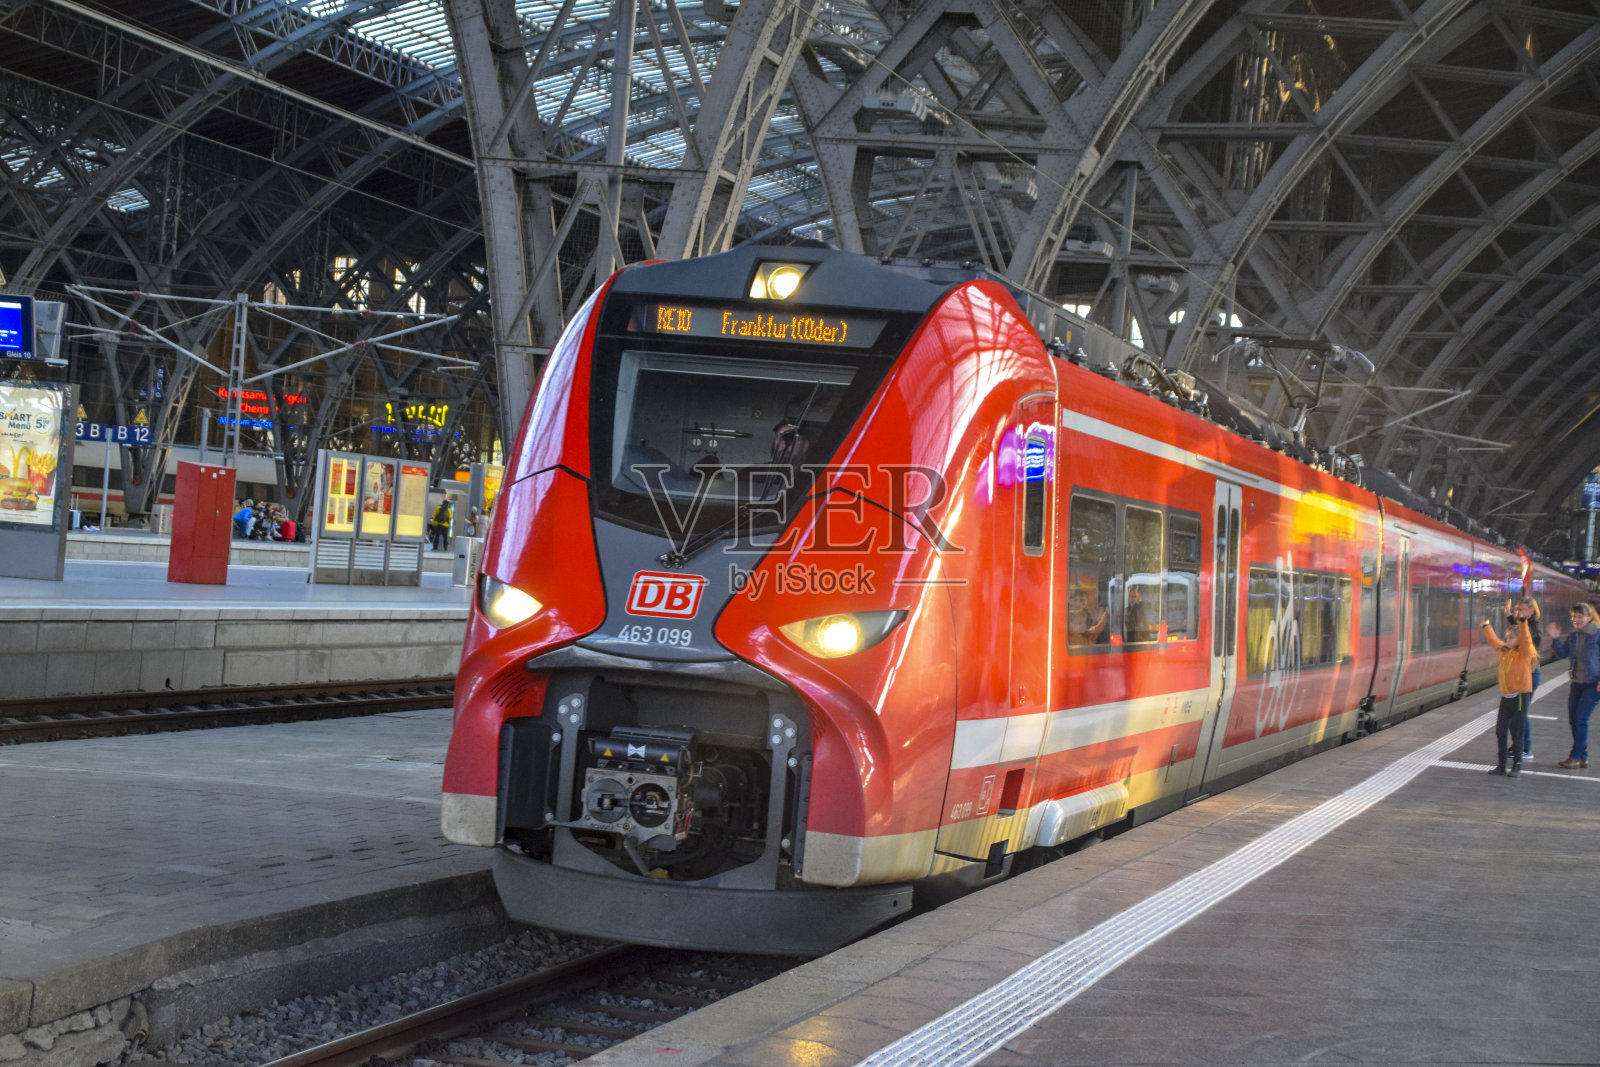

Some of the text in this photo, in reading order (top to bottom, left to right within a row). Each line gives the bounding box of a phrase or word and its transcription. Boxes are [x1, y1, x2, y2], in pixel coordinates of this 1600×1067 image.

[656, 307, 692, 332] RE10
[6, 350, 31, 359] Gleis 10
[8, 421, 31, 430] Menü
[90, 423, 100, 438] B
[117, 425, 149, 442] B 12
[636, 579, 693, 611] DB
[618, 624, 692, 647] 463 099
